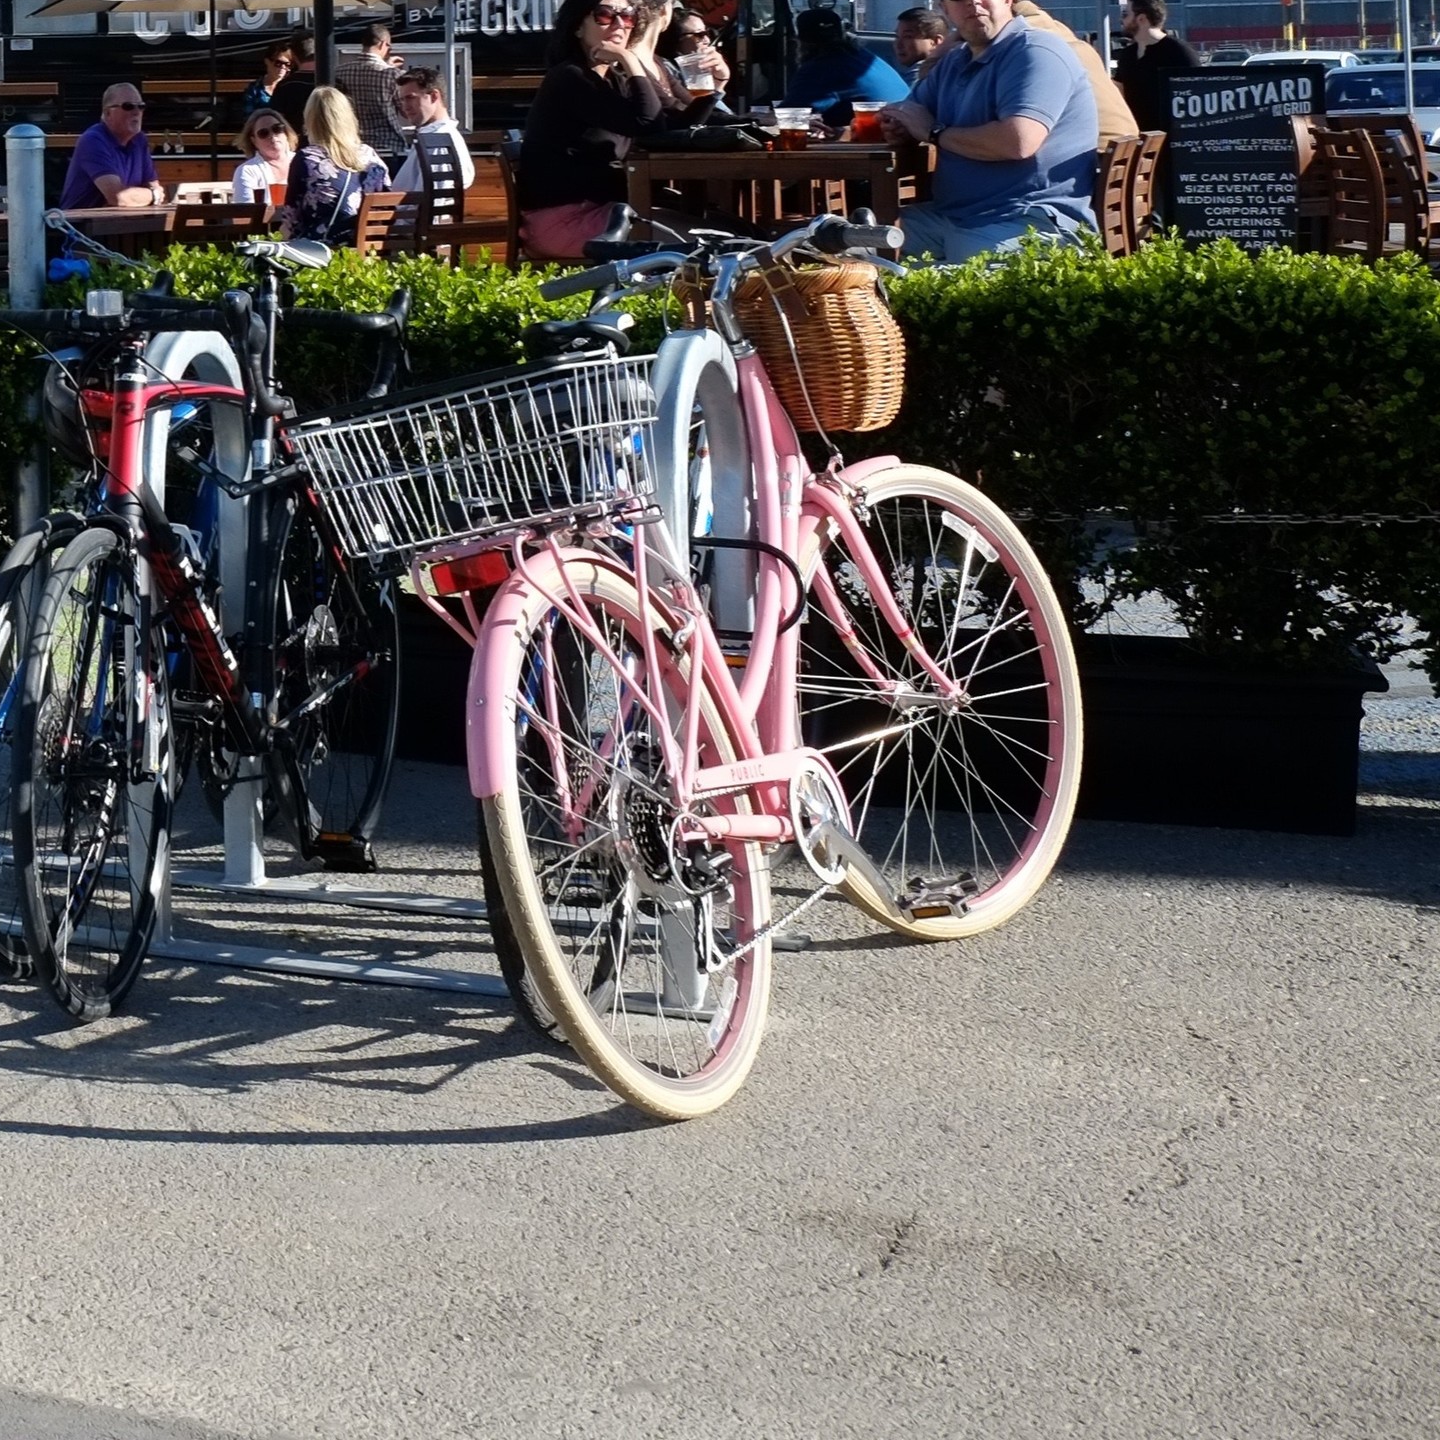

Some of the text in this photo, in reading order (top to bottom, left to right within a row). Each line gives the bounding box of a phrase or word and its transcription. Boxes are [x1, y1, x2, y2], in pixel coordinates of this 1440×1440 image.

[410, 7, 438, 23] BY
[1172, 77, 1312, 119] COURTYARD
[1283, 101, 1312, 116] GRID
[1170, 140, 1201, 148] ENJOY
[1262, 144, 1295, 152] EVENT
[1180, 173, 1297, 182] WE CAN STAGE AN
[1185, 184, 1213, 193] SIZE
[1266, 184, 1296, 192] FRO
[1177, 195, 1296, 204] WEDDINGS TO LAR
[1204, 207, 1286, 216] CORPORATE
[1186, 229, 1297, 238] ANYWHERE IN TH
[1244, 240, 1281, 249] AREA
[730, 764, 765, 781] PUBLIC
